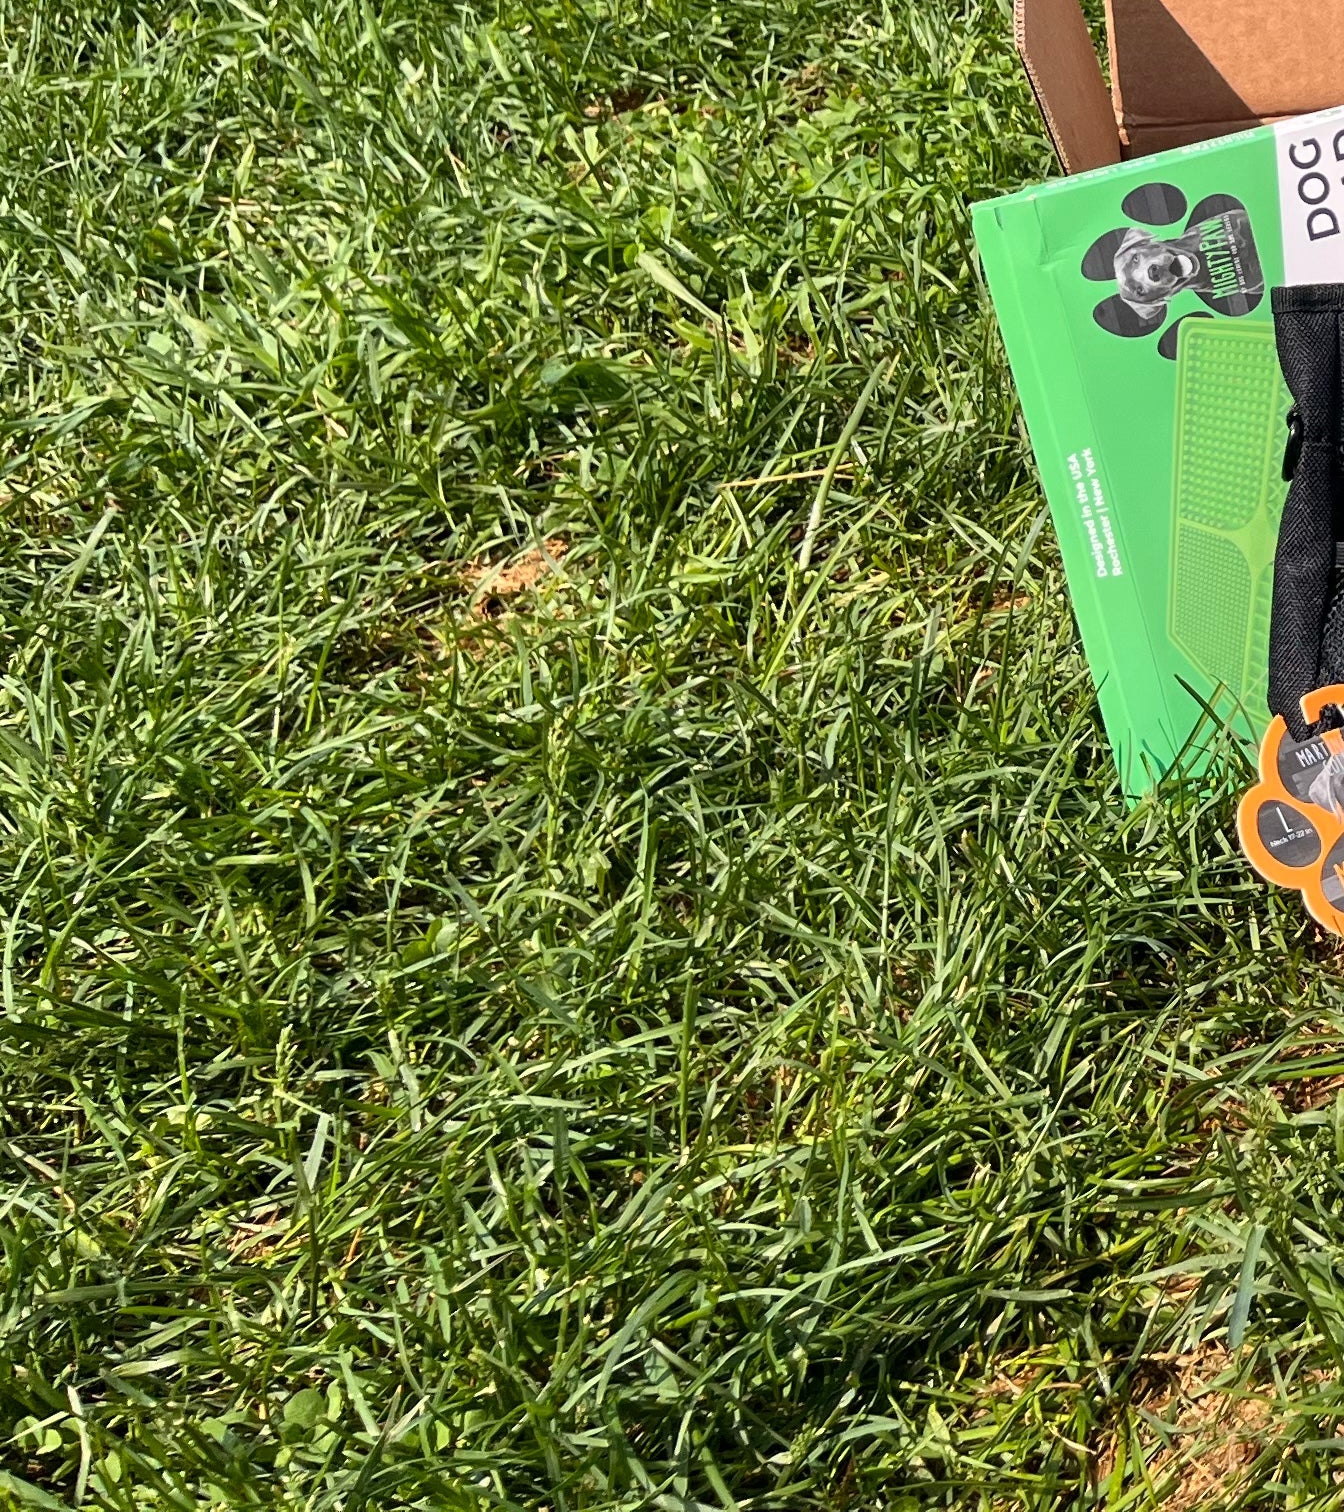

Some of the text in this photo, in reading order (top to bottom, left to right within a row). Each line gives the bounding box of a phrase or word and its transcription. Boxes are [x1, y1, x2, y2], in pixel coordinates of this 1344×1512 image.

[1288, 137, 1341, 242] DOG
[1198, 217, 1240, 300] MIGHTYPAW
[1081, 446, 1098, 478] York
[1089, 477, 1106, 507] New
[1066, 452, 1109, 578] Designed in the USA
[1099, 514, 1124, 578] Rochester
[1275, 806, 1293, 834] L
